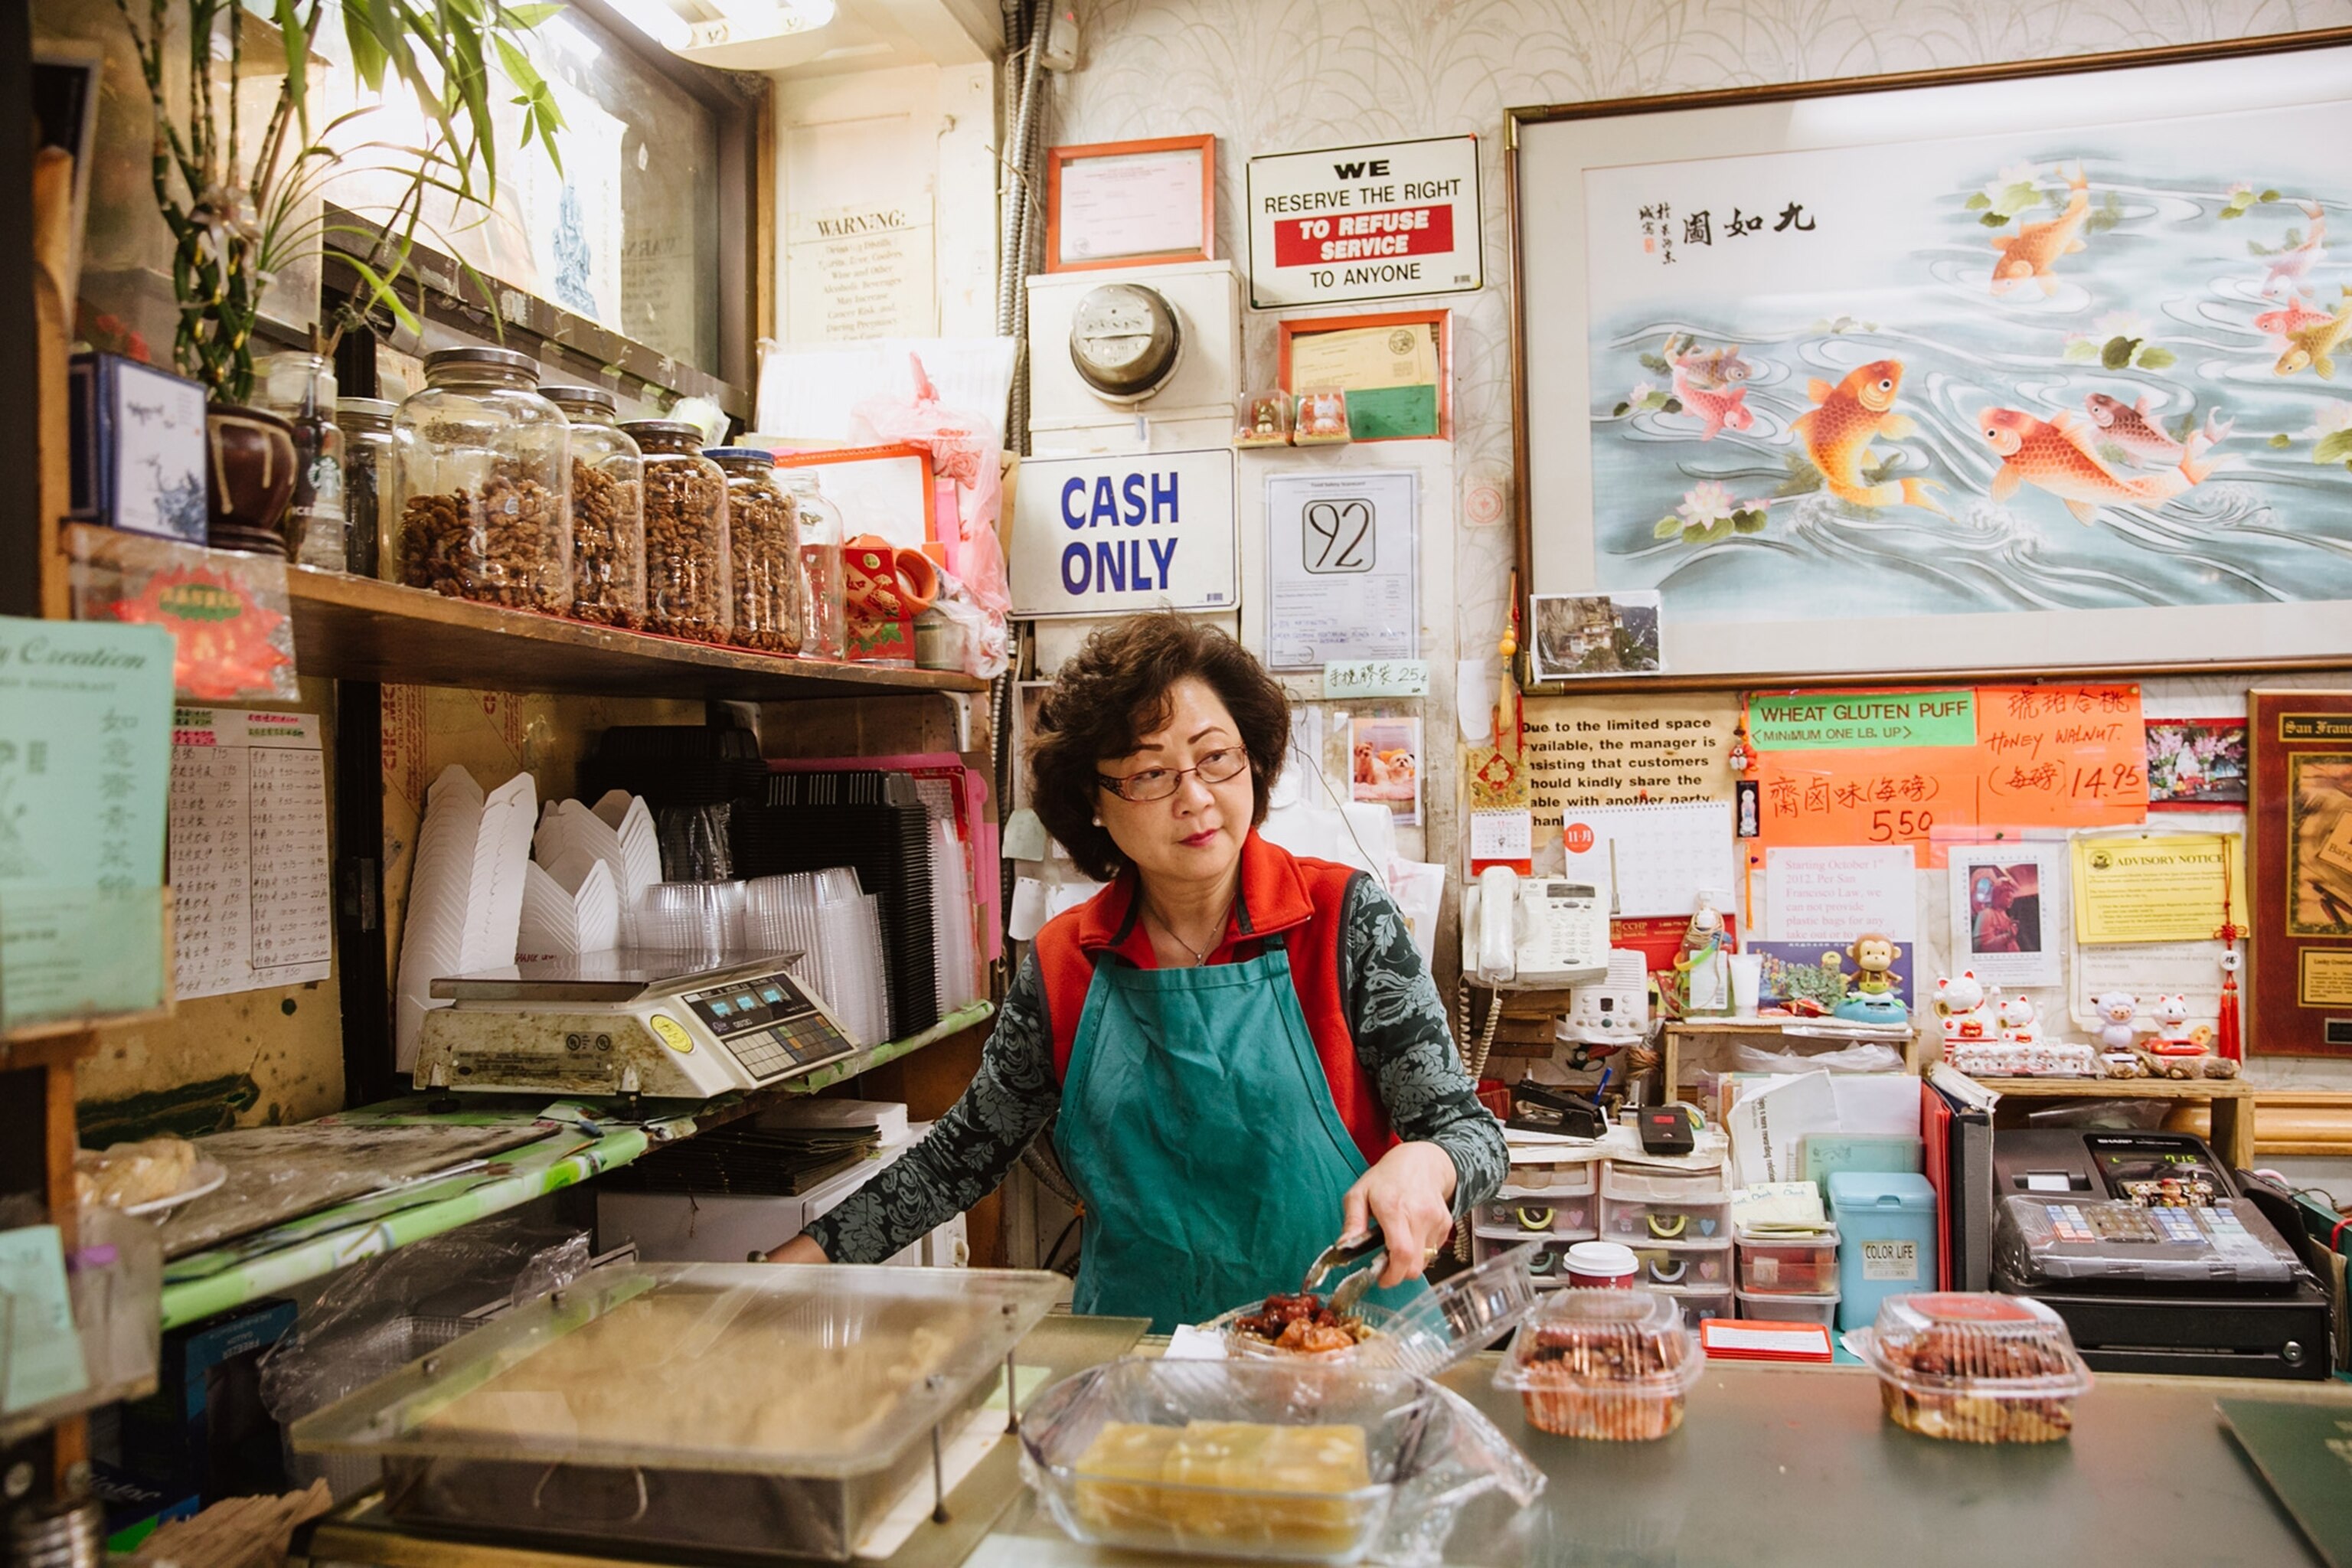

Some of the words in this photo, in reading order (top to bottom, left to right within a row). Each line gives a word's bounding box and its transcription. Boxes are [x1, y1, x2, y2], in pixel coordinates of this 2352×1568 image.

[1333, 159, 1390, 180] WE
[1264, 190, 1351, 214] RESERVE
[1359, 185, 1395, 204] THE
[1403, 178, 1461, 201] RIGHT
[1298, 219, 1331, 240] TO
[1338, 209, 1430, 237] REFUSE
[1320, 234, 1410, 262] SERVICE
[1310, 270, 1334, 289] TO
[1343, 263, 1421, 286] ANYONE
[1060, 471, 1180, 531] CASH
[1308, 502, 1370, 568] 92
[1060, 537, 1179, 596] ONLY
[1760, 706, 1827, 723] WHEAT
[1833, 703, 1909, 720] GLUTEN
[1919, 700, 1968, 718] PUFF
[1522, 720, 1550, 734] Due
[1555, 721, 1570, 733] to
[1576, 720, 1600, 733] the
[1606, 718, 1660, 731] limited
[1665, 718, 1712, 731] space
[2285, 720, 2312, 734] San
[1826, 728, 1854, 740] ONE
[1530, 740, 1594, 753] vailable,
[1599, 738, 1624, 750] the
[1630, 739, 1697, 753] manager
[1703, 736, 1717, 748] is
[1984, 730, 2043, 761] HONEY
[1530, 760, 1586, 771] nsisting
[1591, 757, 1622, 769] that
[1628, 756, 1710, 769] customers
[1530, 778, 1572, 789] hould
[1577, 776, 1623, 791] kindly
[1628, 776, 1671, 788] share
[1677, 775, 1703, 786] the
[1530, 796, 1560, 808] able
[1566, 795, 1599, 806] with
[1605, 794, 1664, 806] another
[1533, 816, 1564, 827] han
[1785, 859, 1825, 871] Starting
[1828, 859, 1869, 870] October
[2117, 854, 2174, 867] ADVISORY
[2178, 854, 2225, 864] NOTICE
[1817, 874, 1834, 884] Per
[1837, 874, 1856, 884] San
[1785, 888, 1835, 898] Francisco
[1867, 890, 1882, 898] we
[1785, 903, 1803, 912] can
[1806, 903, 1823, 912] not
[1825, 901, 1864, 914] provide
[1785, 916, 1818, 927] plastic
[1821, 916, 1845, 927] bags
[1848, 915, 1863, 926] for
[1866, 917, 1884, 928] any
[1785, 929, 1808, 939] take
[1810, 930, 1828, 939] out
[1829, 931, 1841, 939] or
[1843, 930, 1854, 939] to
[1865, 1244, 1895, 1259] COLOR
[1896, 1244, 1914, 1259] LIFE
